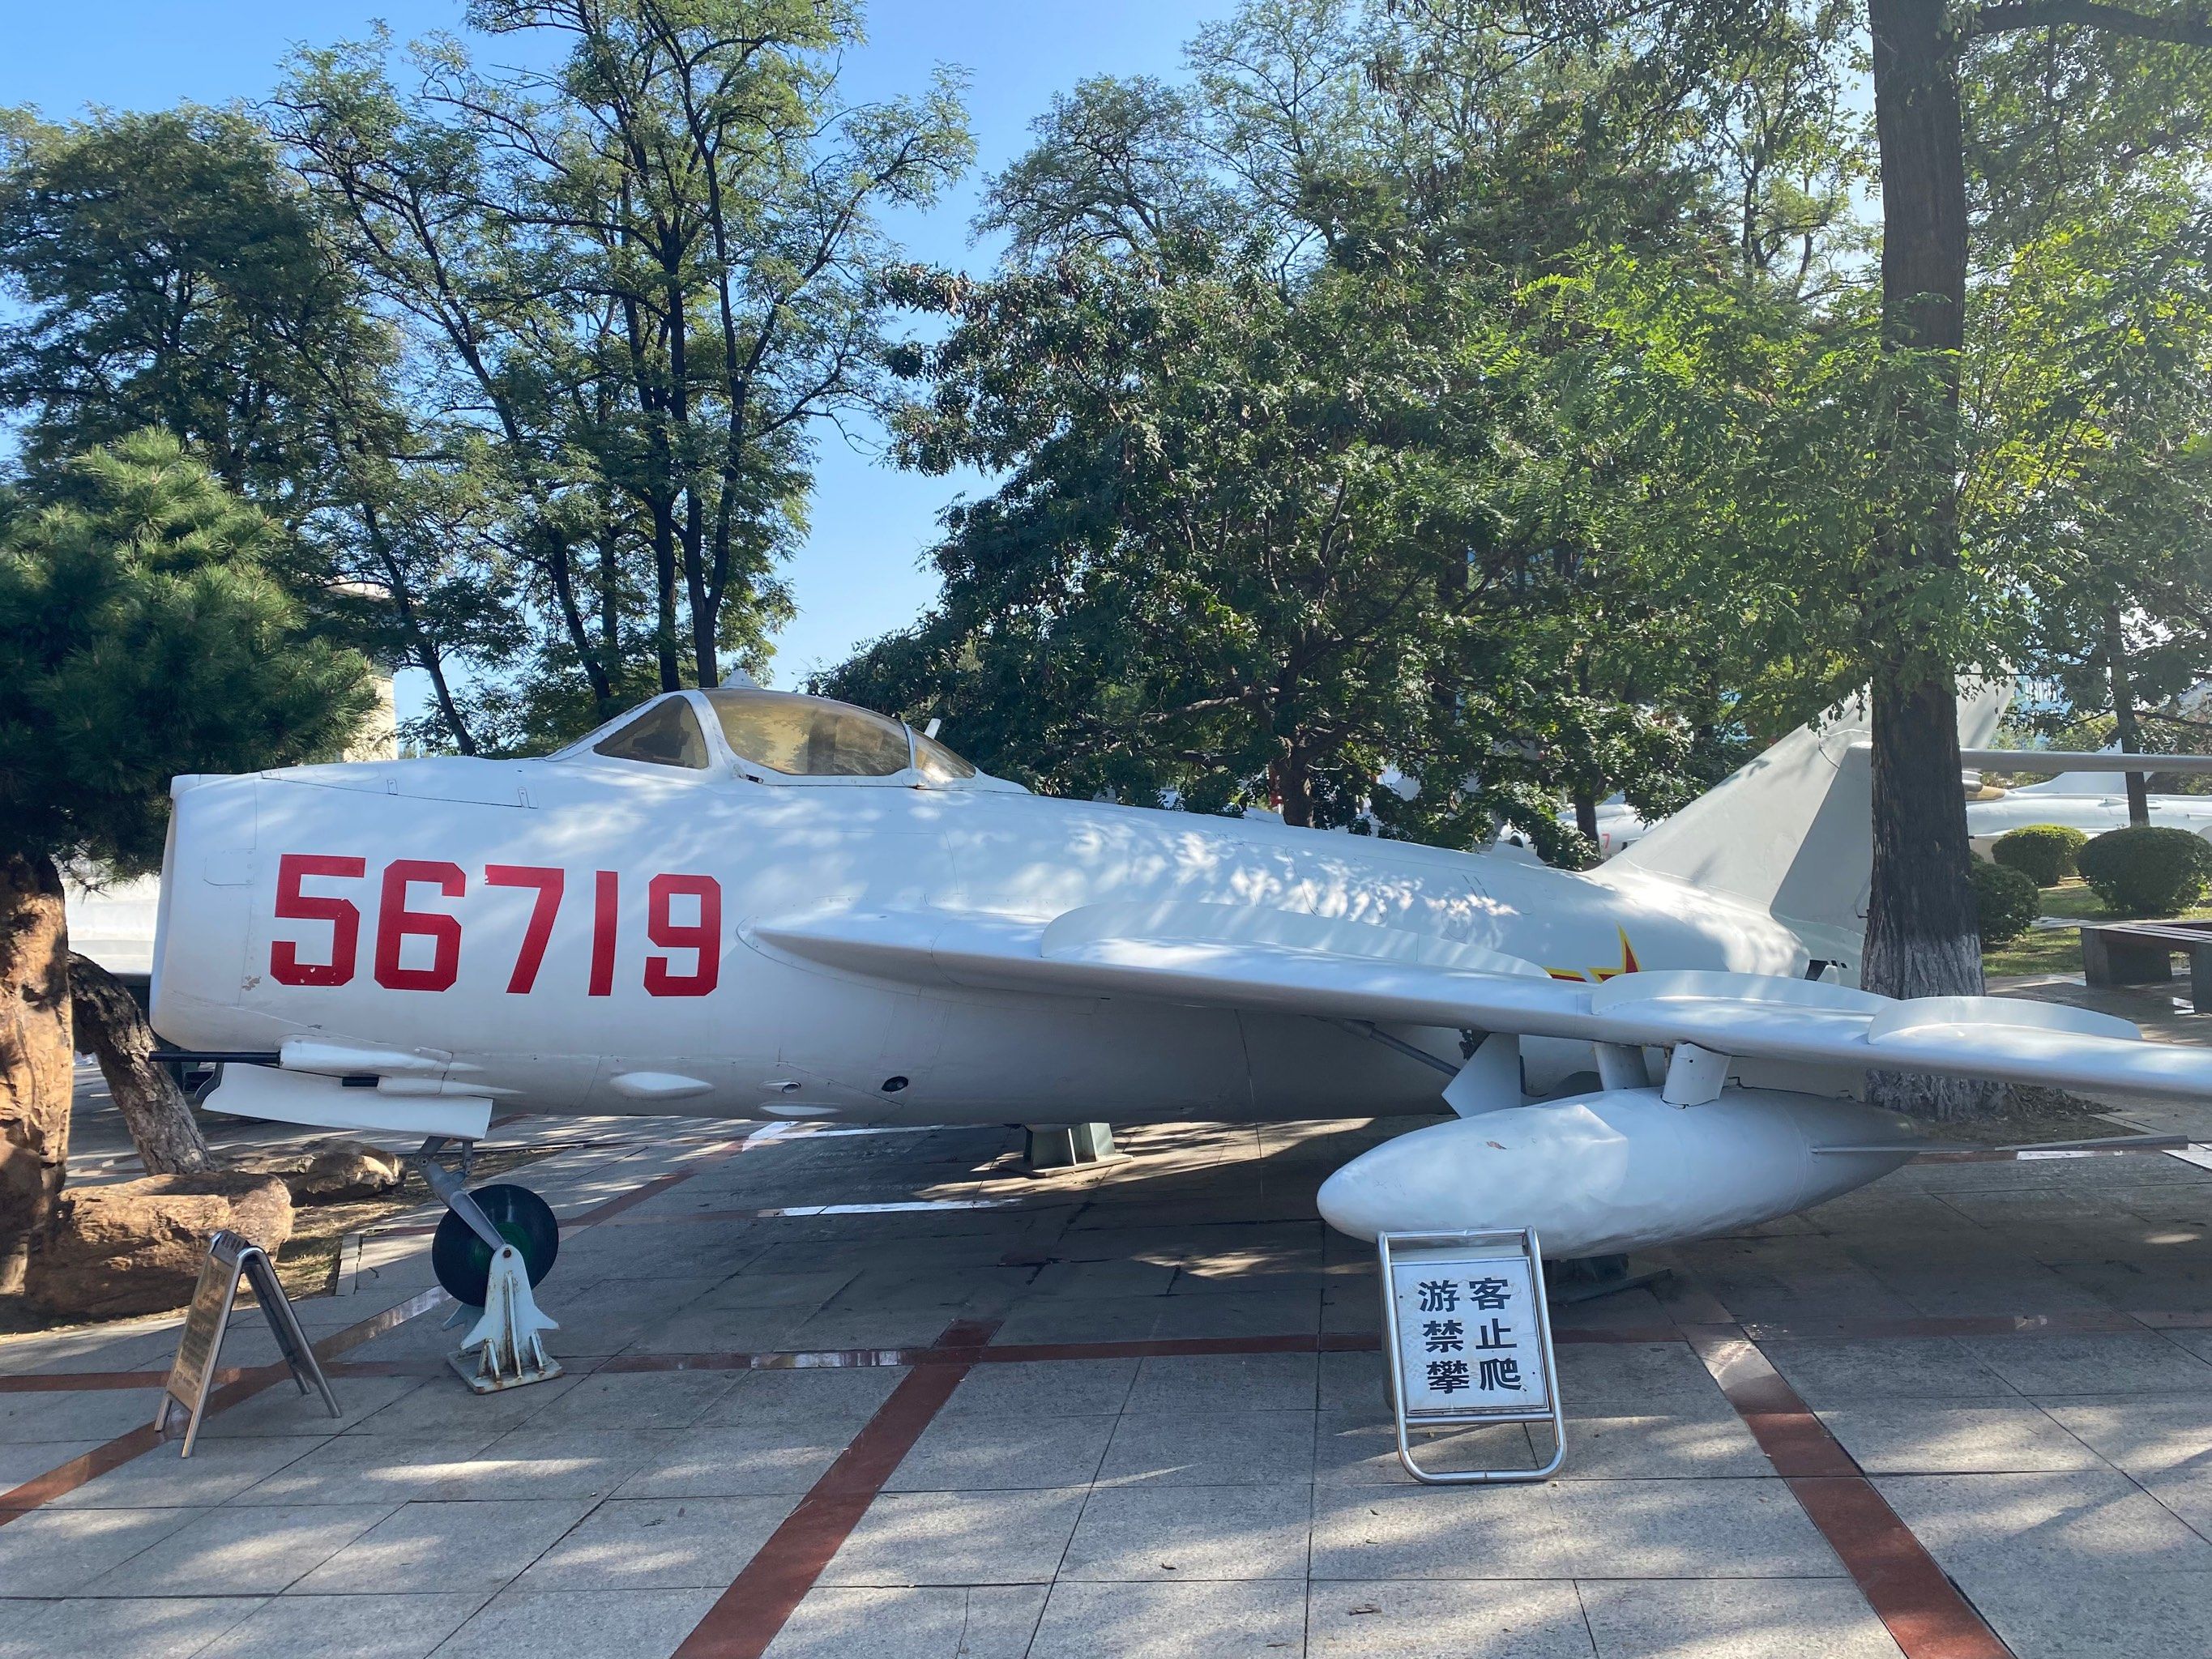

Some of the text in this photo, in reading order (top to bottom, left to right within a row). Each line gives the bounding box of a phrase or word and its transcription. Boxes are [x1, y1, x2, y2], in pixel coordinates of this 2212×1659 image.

[271, 854, 721, 996] 56719
[1418, 1277, 1512, 1312] 游客
[1423, 1318, 1518, 1353] 禁止
[1427, 1358, 1522, 1394] 攀爬
